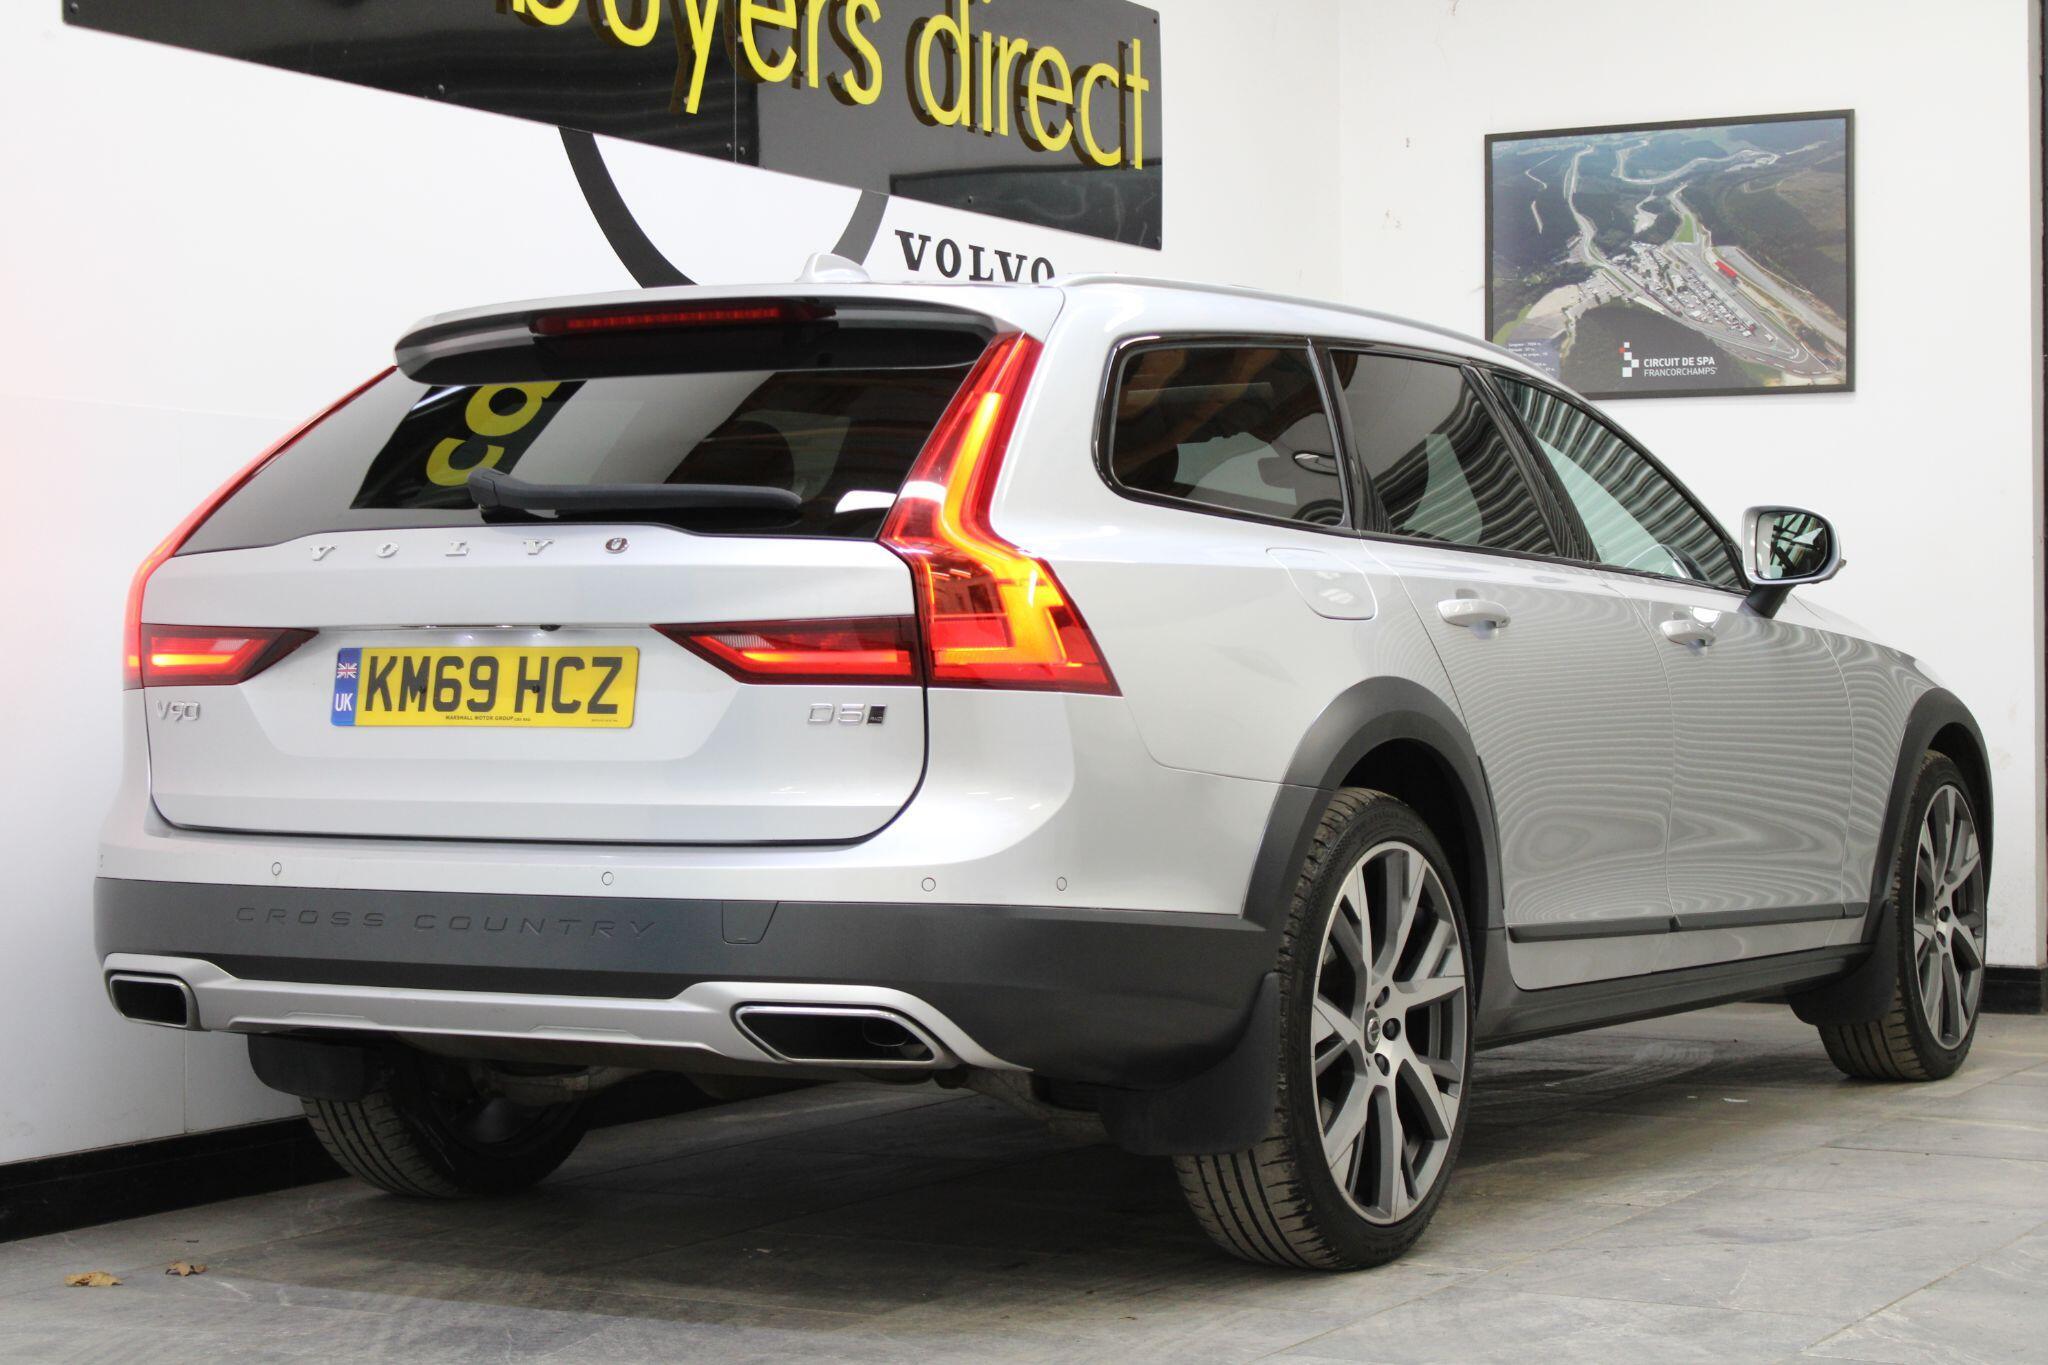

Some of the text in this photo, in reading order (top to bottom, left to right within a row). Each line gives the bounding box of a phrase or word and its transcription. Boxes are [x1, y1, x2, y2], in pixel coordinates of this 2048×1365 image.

[513, 0, 1149, 170] yers direct
[895, 229, 1055, 284] VOLVO
[1643, 356, 1715, 367] CIRCUIT DE SPA
[1643, 367, 1716, 377] FRANCORCHAMPS
[310, 536, 630, 562] VOLVO
[365, 655, 623, 715] KM69 HCZ
[157, 700, 201, 722] V90
[335, 693, 353, 712] UK
[808, 703, 866, 723] D5
[236, 906, 658, 938] CROSS COUNTRY
